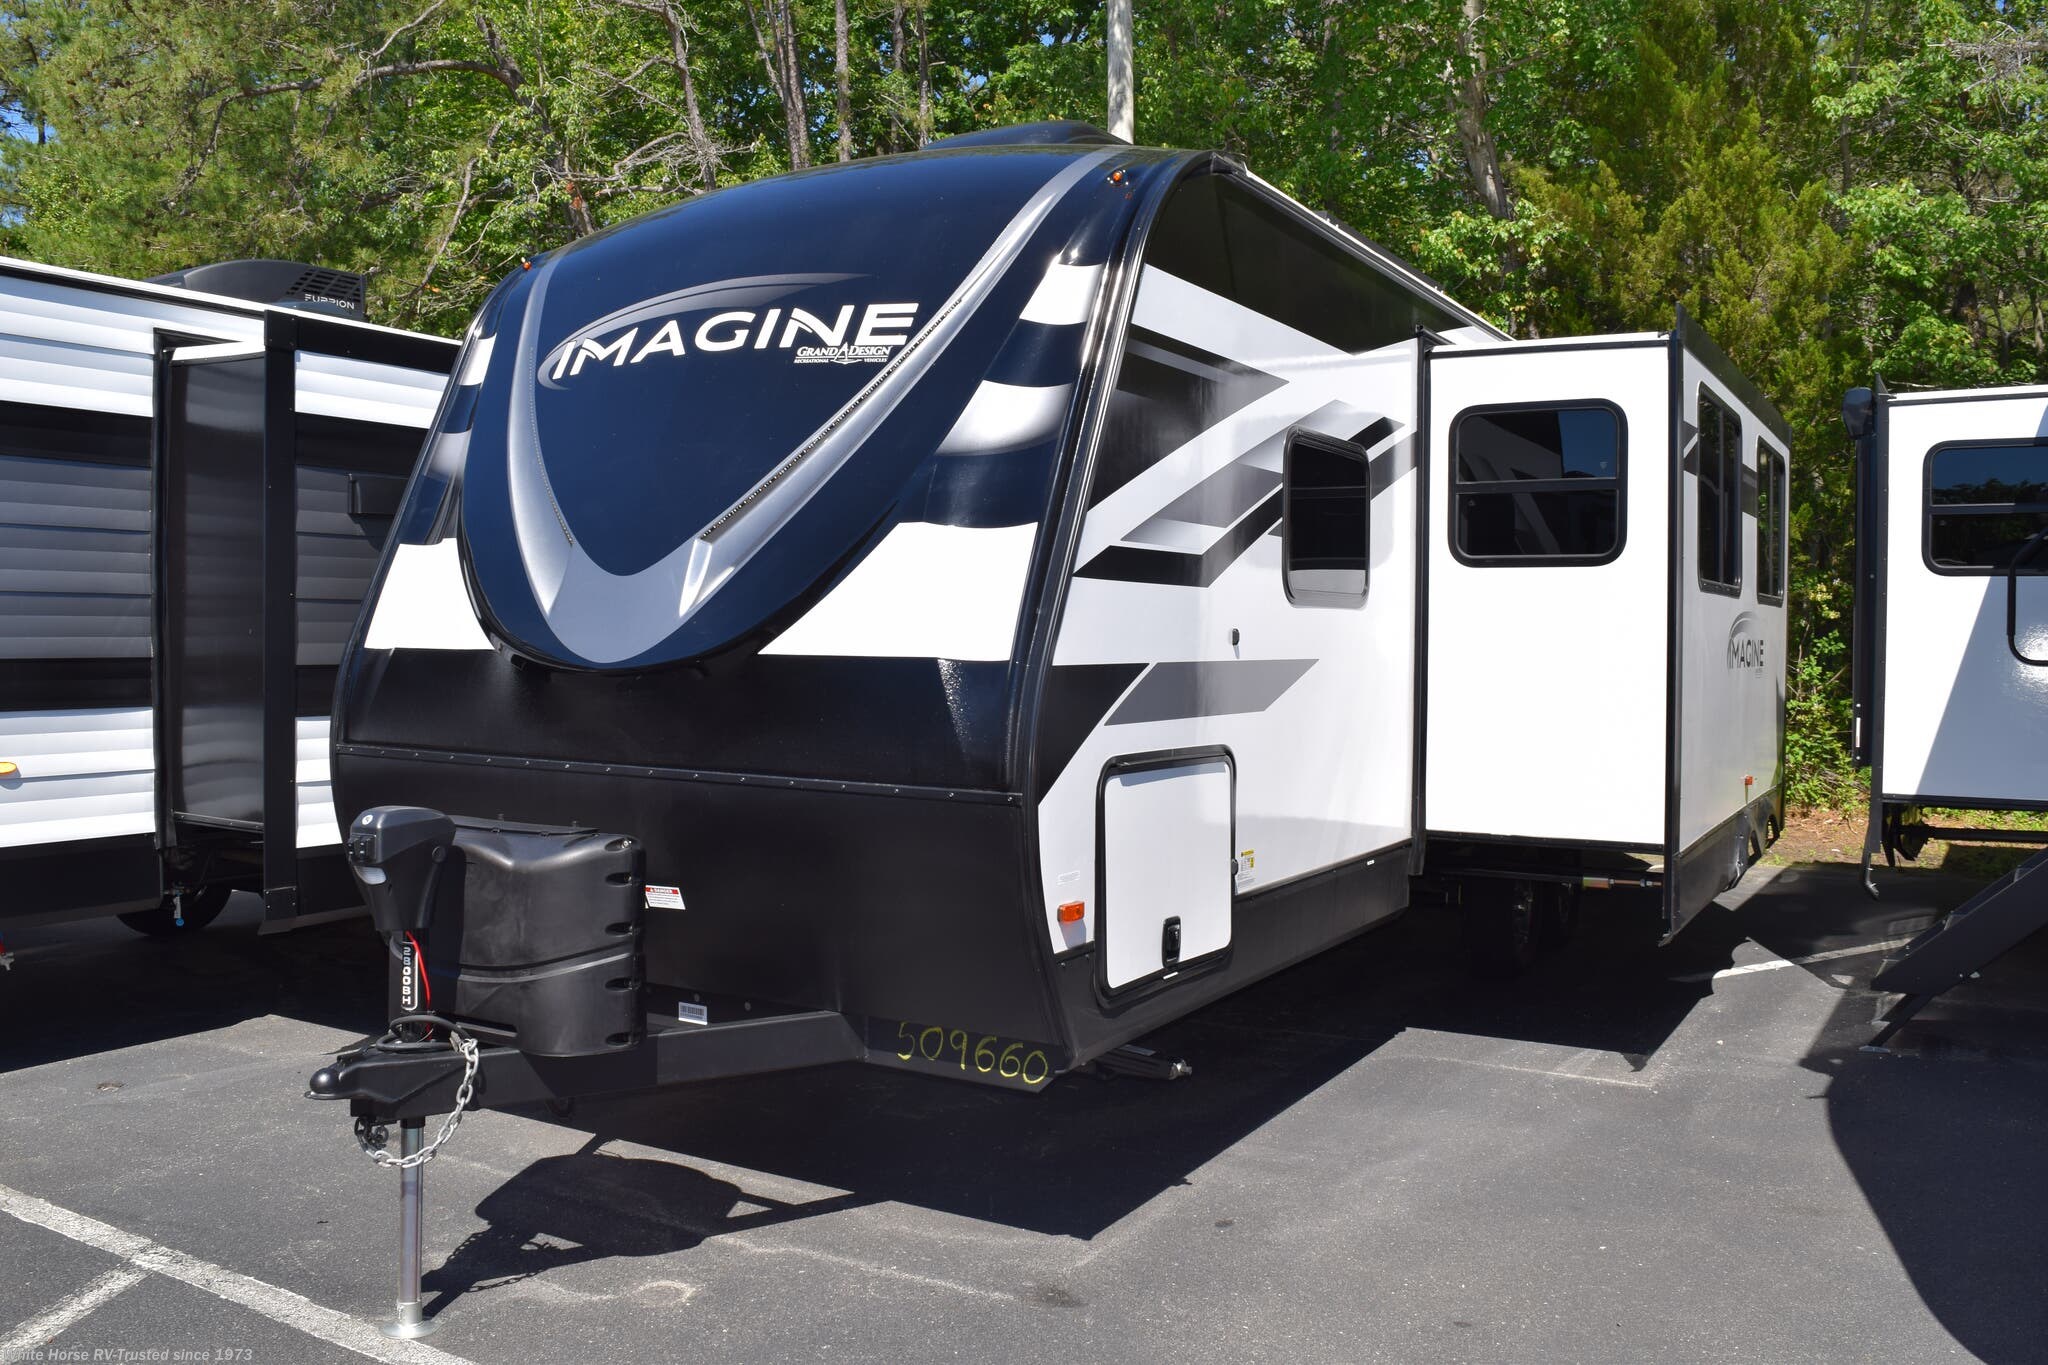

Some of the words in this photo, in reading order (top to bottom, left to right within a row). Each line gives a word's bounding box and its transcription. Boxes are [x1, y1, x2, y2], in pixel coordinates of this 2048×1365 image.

[304, 293, 355, 310] FURRION
[552, 303, 919, 380] IMAGINE
[797, 346, 838, 357] GRAND
[849, 345, 893, 356] DESIGN
[1728, 639, 1764, 669] IMAGINE
[897, 1020, 1049, 1084] 509660
